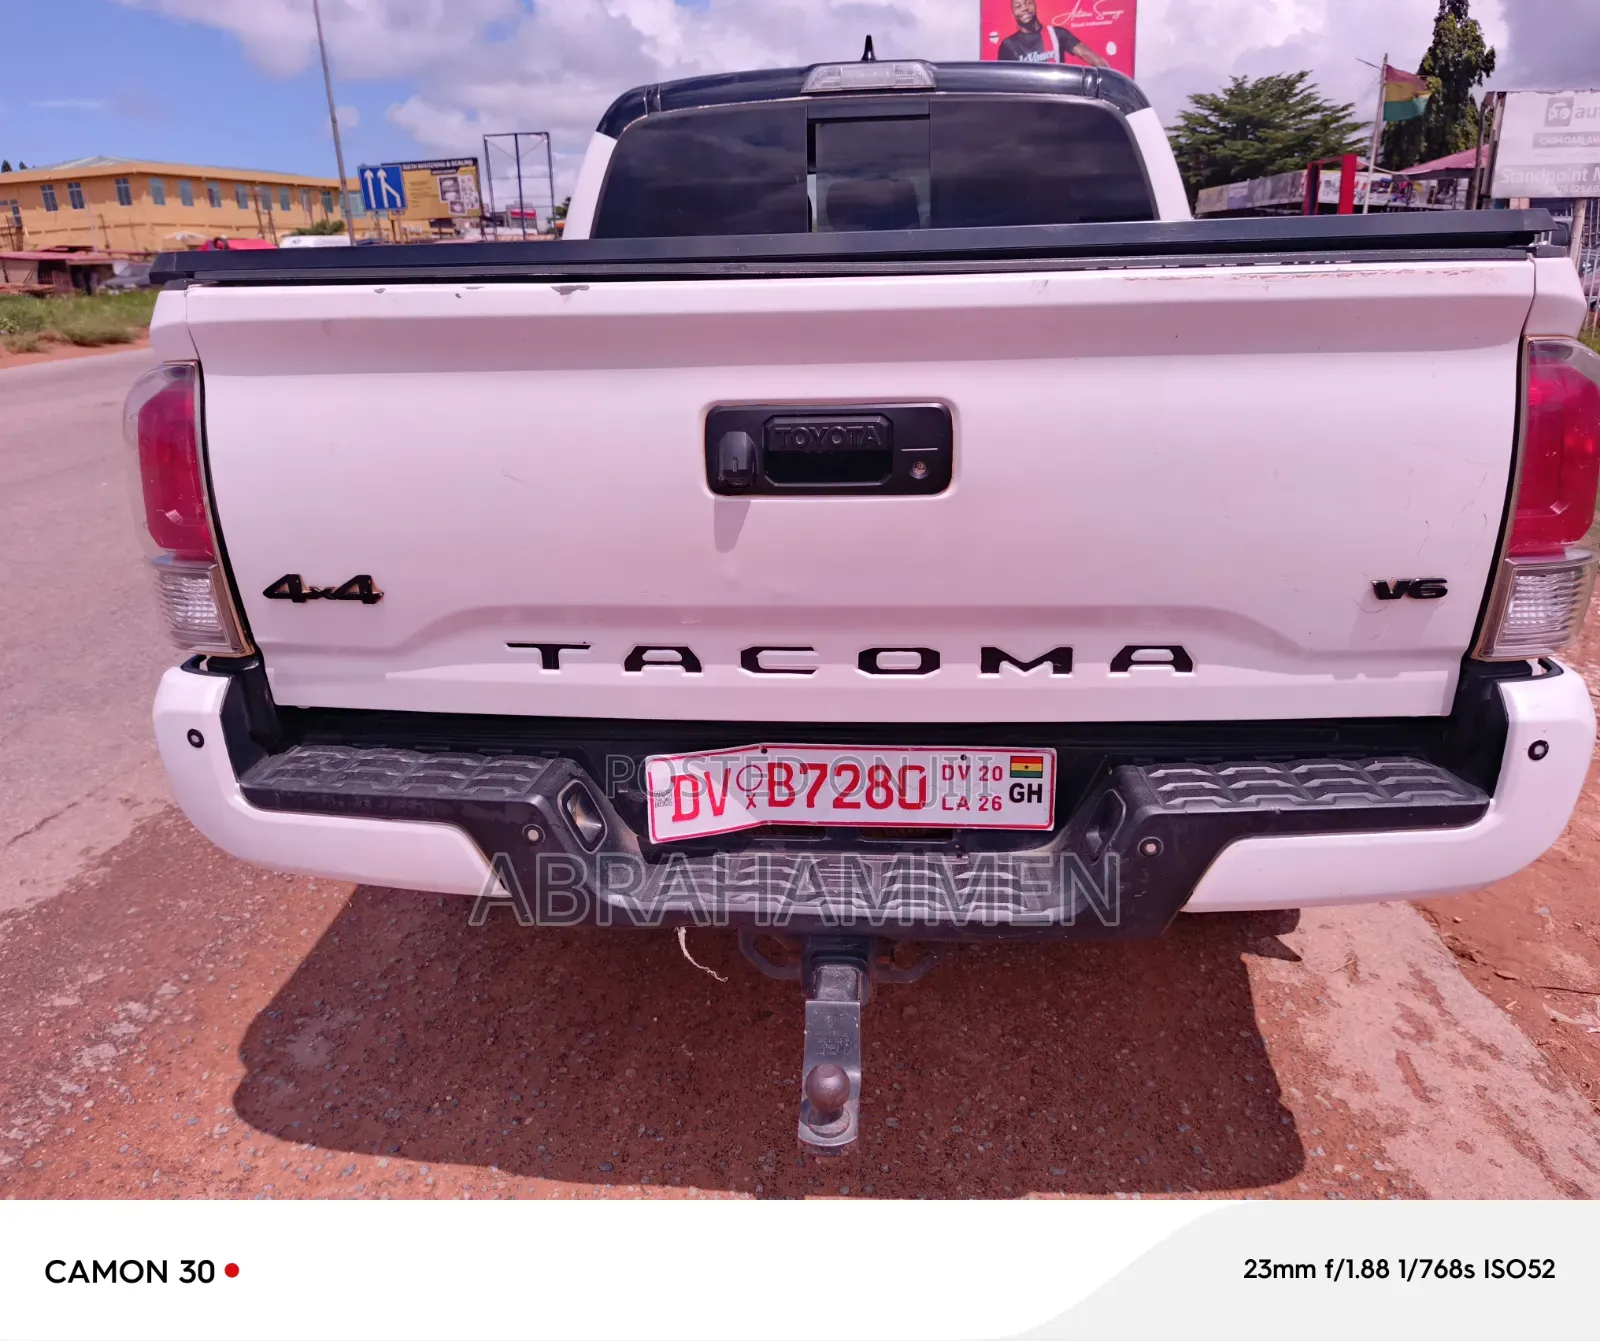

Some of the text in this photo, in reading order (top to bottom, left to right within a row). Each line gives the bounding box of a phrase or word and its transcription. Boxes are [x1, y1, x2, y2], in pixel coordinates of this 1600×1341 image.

[1575, 107, 1600, 119] au
[1501, 168, 1589, 187] Standpoint
[775, 425, 882, 448] TOYOTA
[262, 573, 384, 604] 4x4
[1371, 577, 1448, 600] V6
[506, 642, 1194, 675] TACOMA
[941, 765, 1003, 781] DV 20
[671, 768, 731, 822] DV
[767, 762, 927, 811] B7280
[1009, 782, 1043, 804] GH
[941, 796, 1003, 811] LA 26
